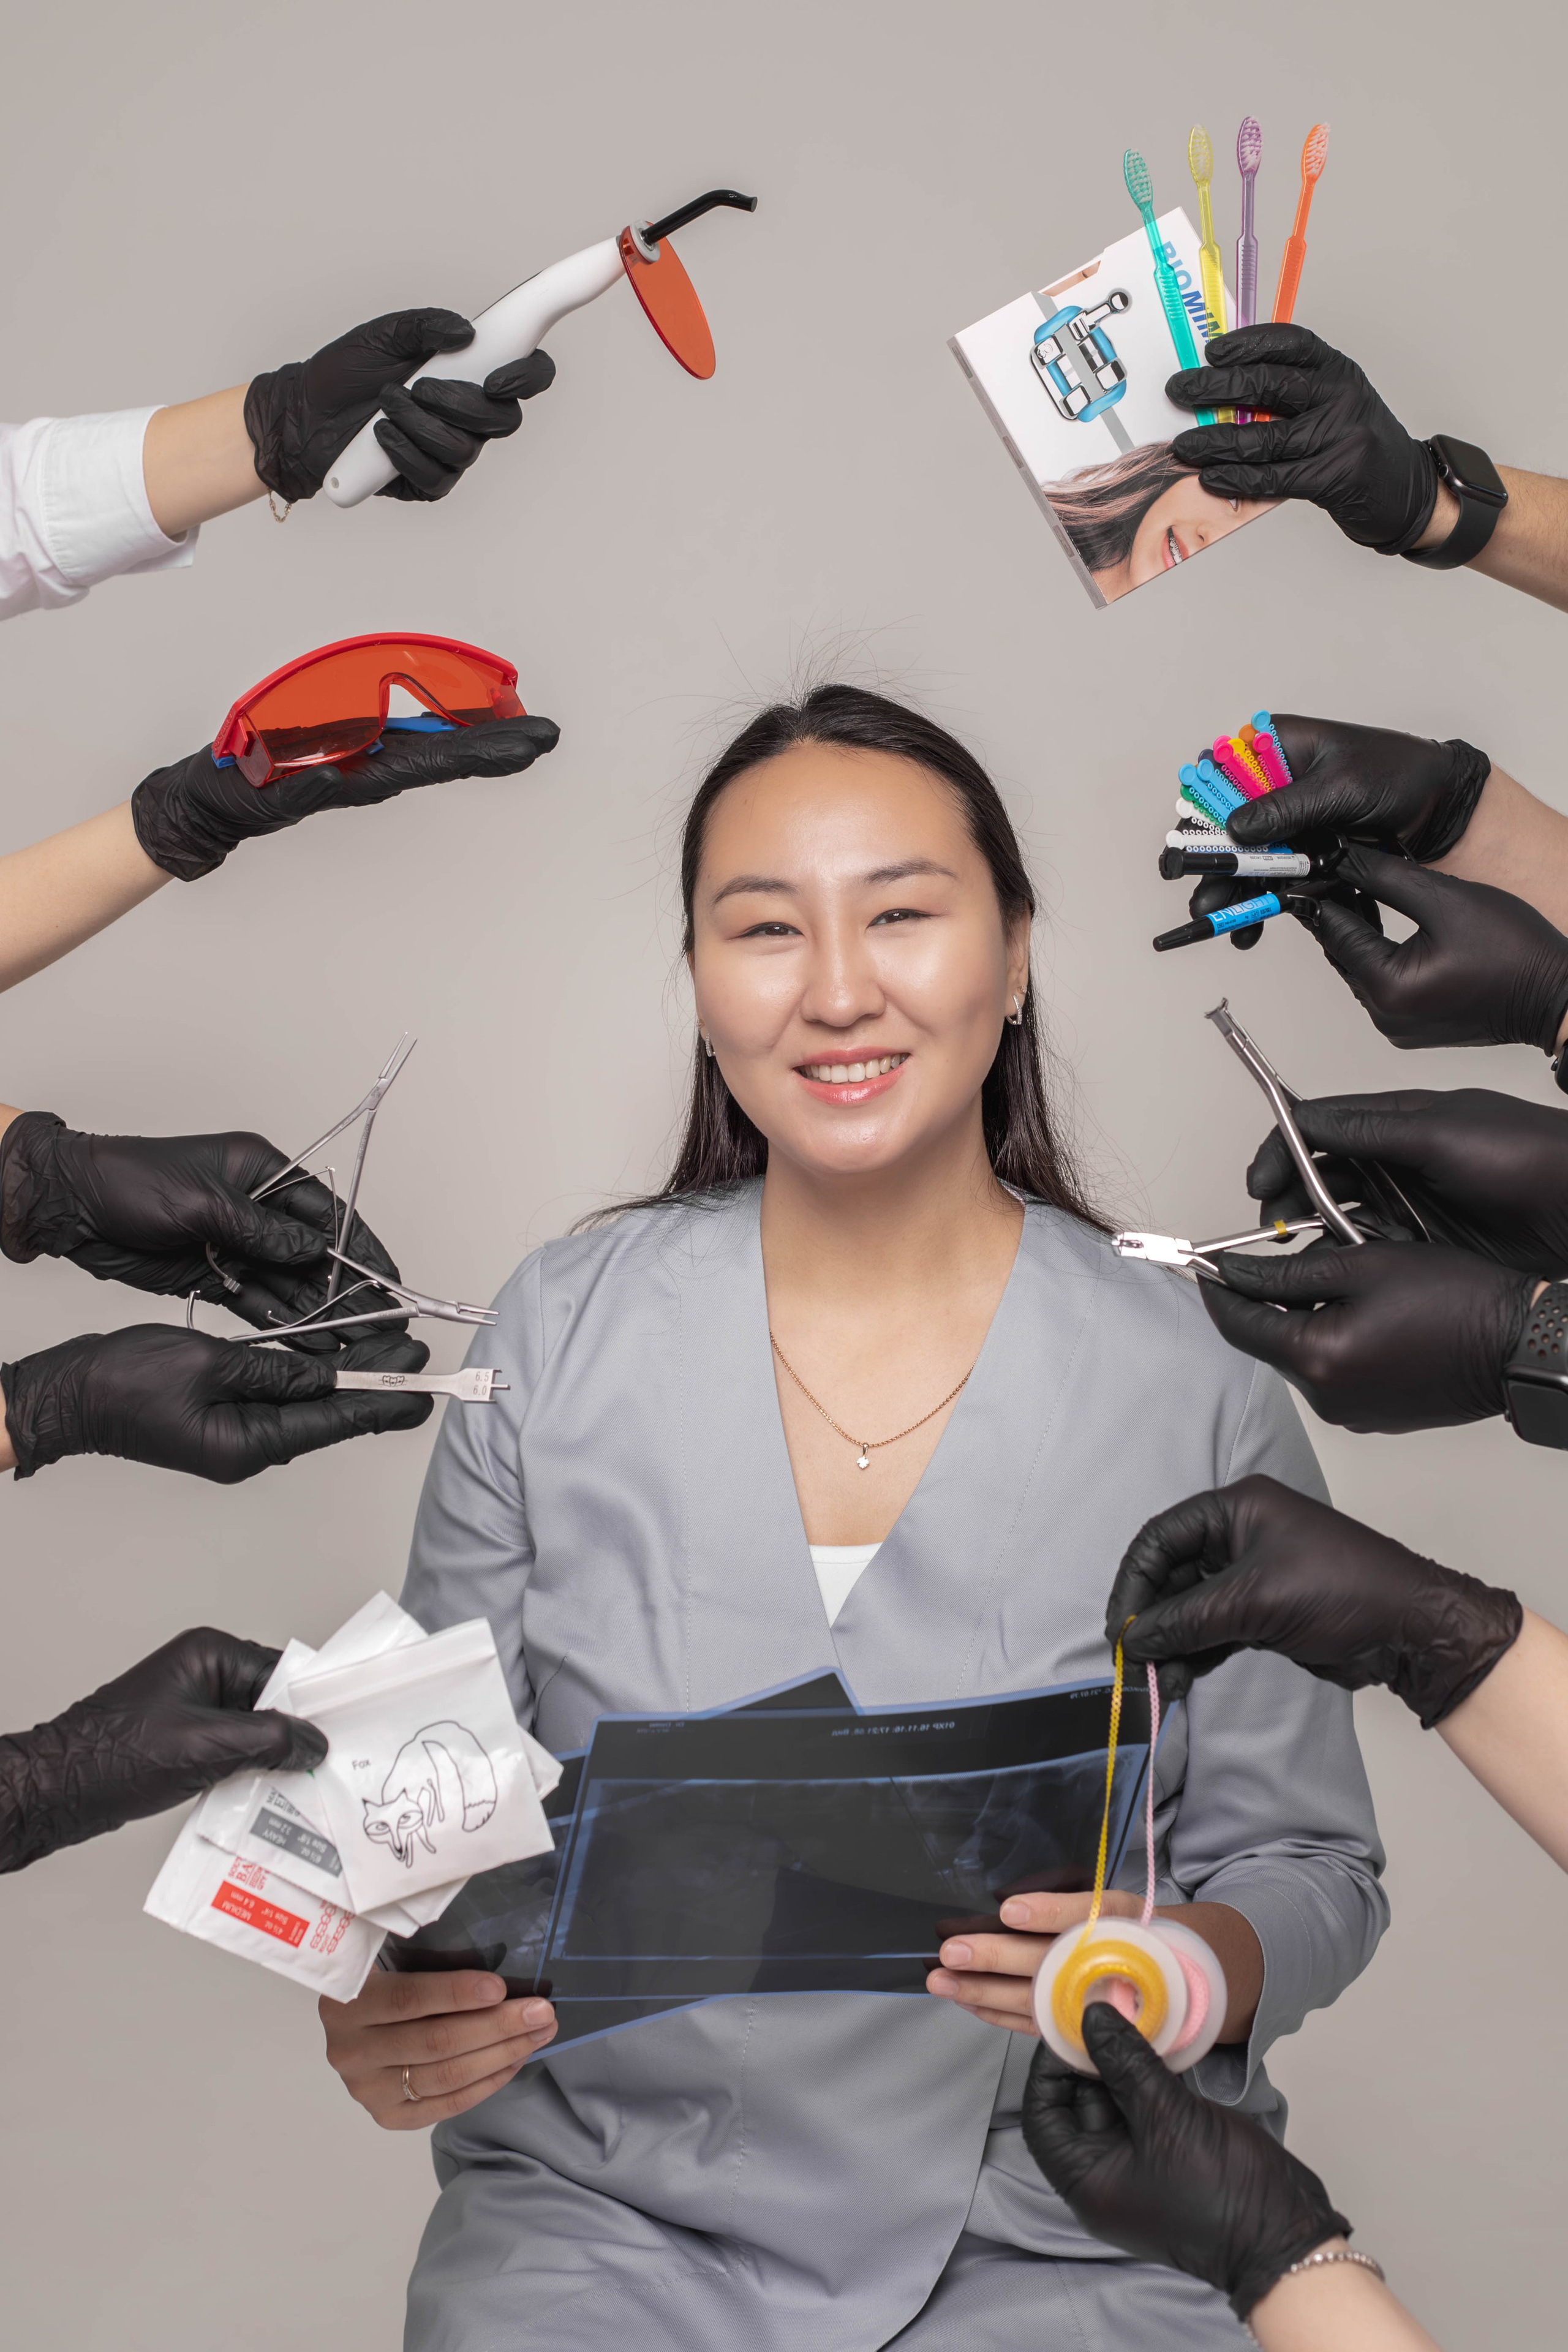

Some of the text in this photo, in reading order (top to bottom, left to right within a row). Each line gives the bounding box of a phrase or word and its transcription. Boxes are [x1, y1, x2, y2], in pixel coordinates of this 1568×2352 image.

[1208, 895, 1275, 922] ENLIGHT
[475, 1371, 489, 1382] 6.5
[473, 1385, 487, 1395] 6.0
[352, 1760, 371, 1770] Fox
[262, 1828, 287, 1846] HEAVY
[230, 1890, 244, 1902] mm
[221, 1901, 252, 1921] MEDIUM
[274, 1912, 289, 1926] Size
